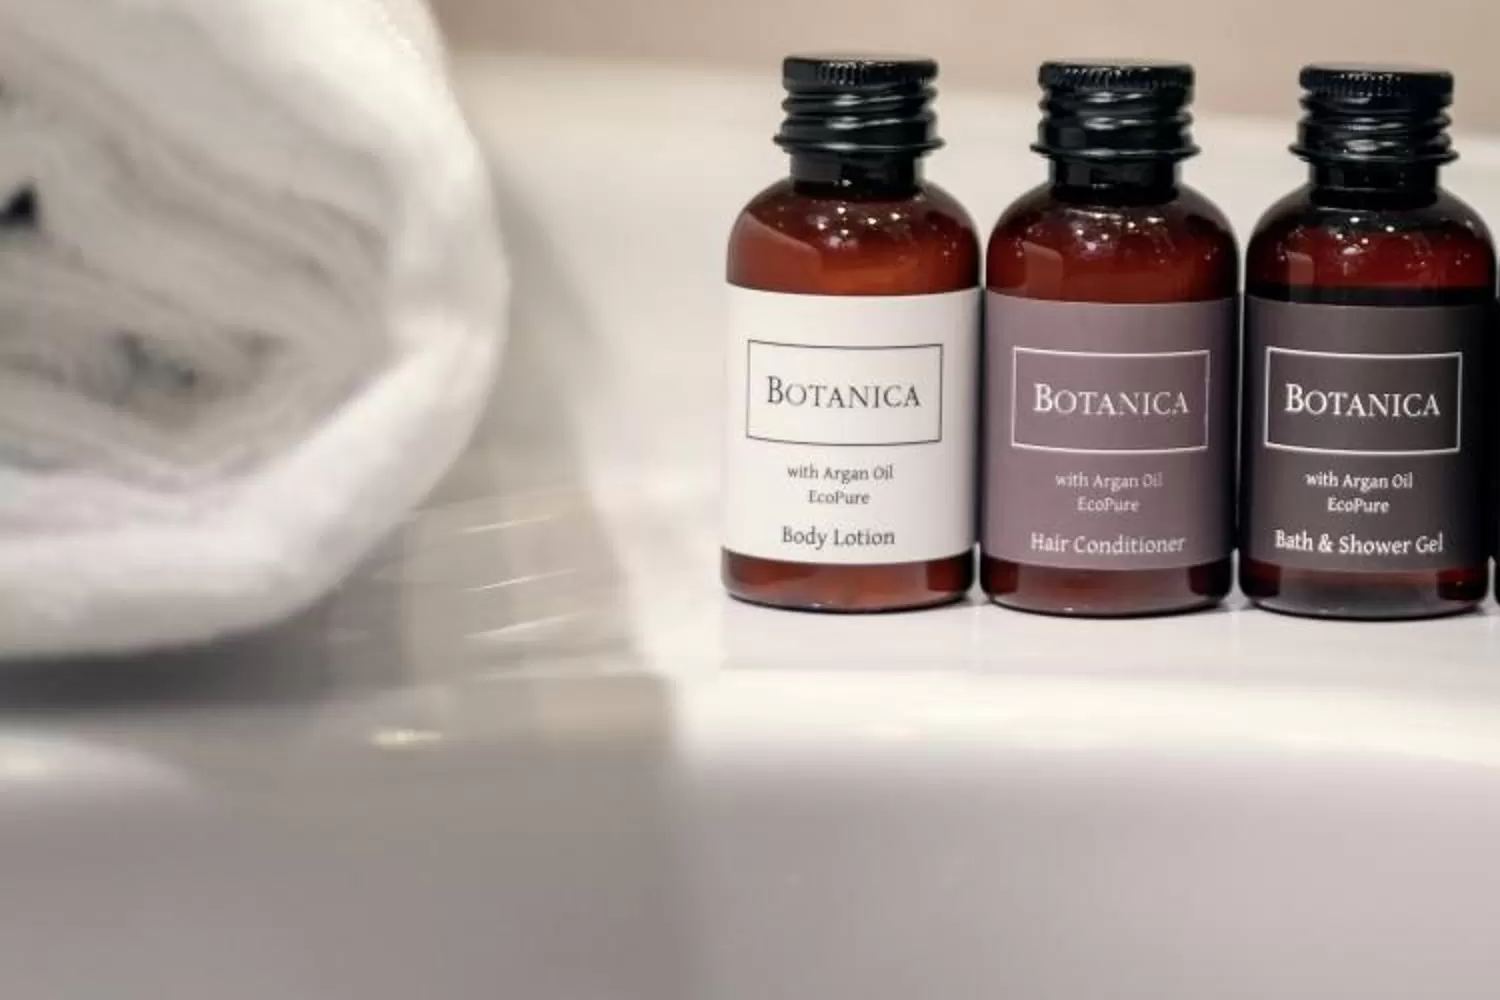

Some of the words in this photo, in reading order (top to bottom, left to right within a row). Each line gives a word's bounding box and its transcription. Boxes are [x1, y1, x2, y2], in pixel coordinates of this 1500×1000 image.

[767, 376, 921, 409] BOTANICA
[1033, 383, 1189, 416] BOTANICA
[1285, 383, 1441, 418] BOTANICA
[787, 464, 819, 480] with
[823, 465, 870, 486] Argan
[873, 465, 894, 481] Oil
[1055, 472, 1089, 488] with
[1092, 473, 1139, 494] Argan
[1142, 472, 1163, 489] Oil
[1306, 472, 1339, 488] with
[1342, 474, 1389, 495] Argan
[1392, 472, 1413, 489] Oil
[808, 490, 870, 505] EcoPure
[1076, 497, 1140, 513] EcoPure
[1327, 497, 1390, 514] EcoPure
[782, 526, 828, 551] Body
[832, 527, 896, 547] Lotion
[1031, 532, 1071, 553] Hair
[1073, 534, 1185, 554] Conditioner
[1275, 530, 1314, 553] Bath
[1318, 534, 1333, 553] &
[1338, 534, 1411, 556] Shower
[1415, 533, 1444, 554] Gel
